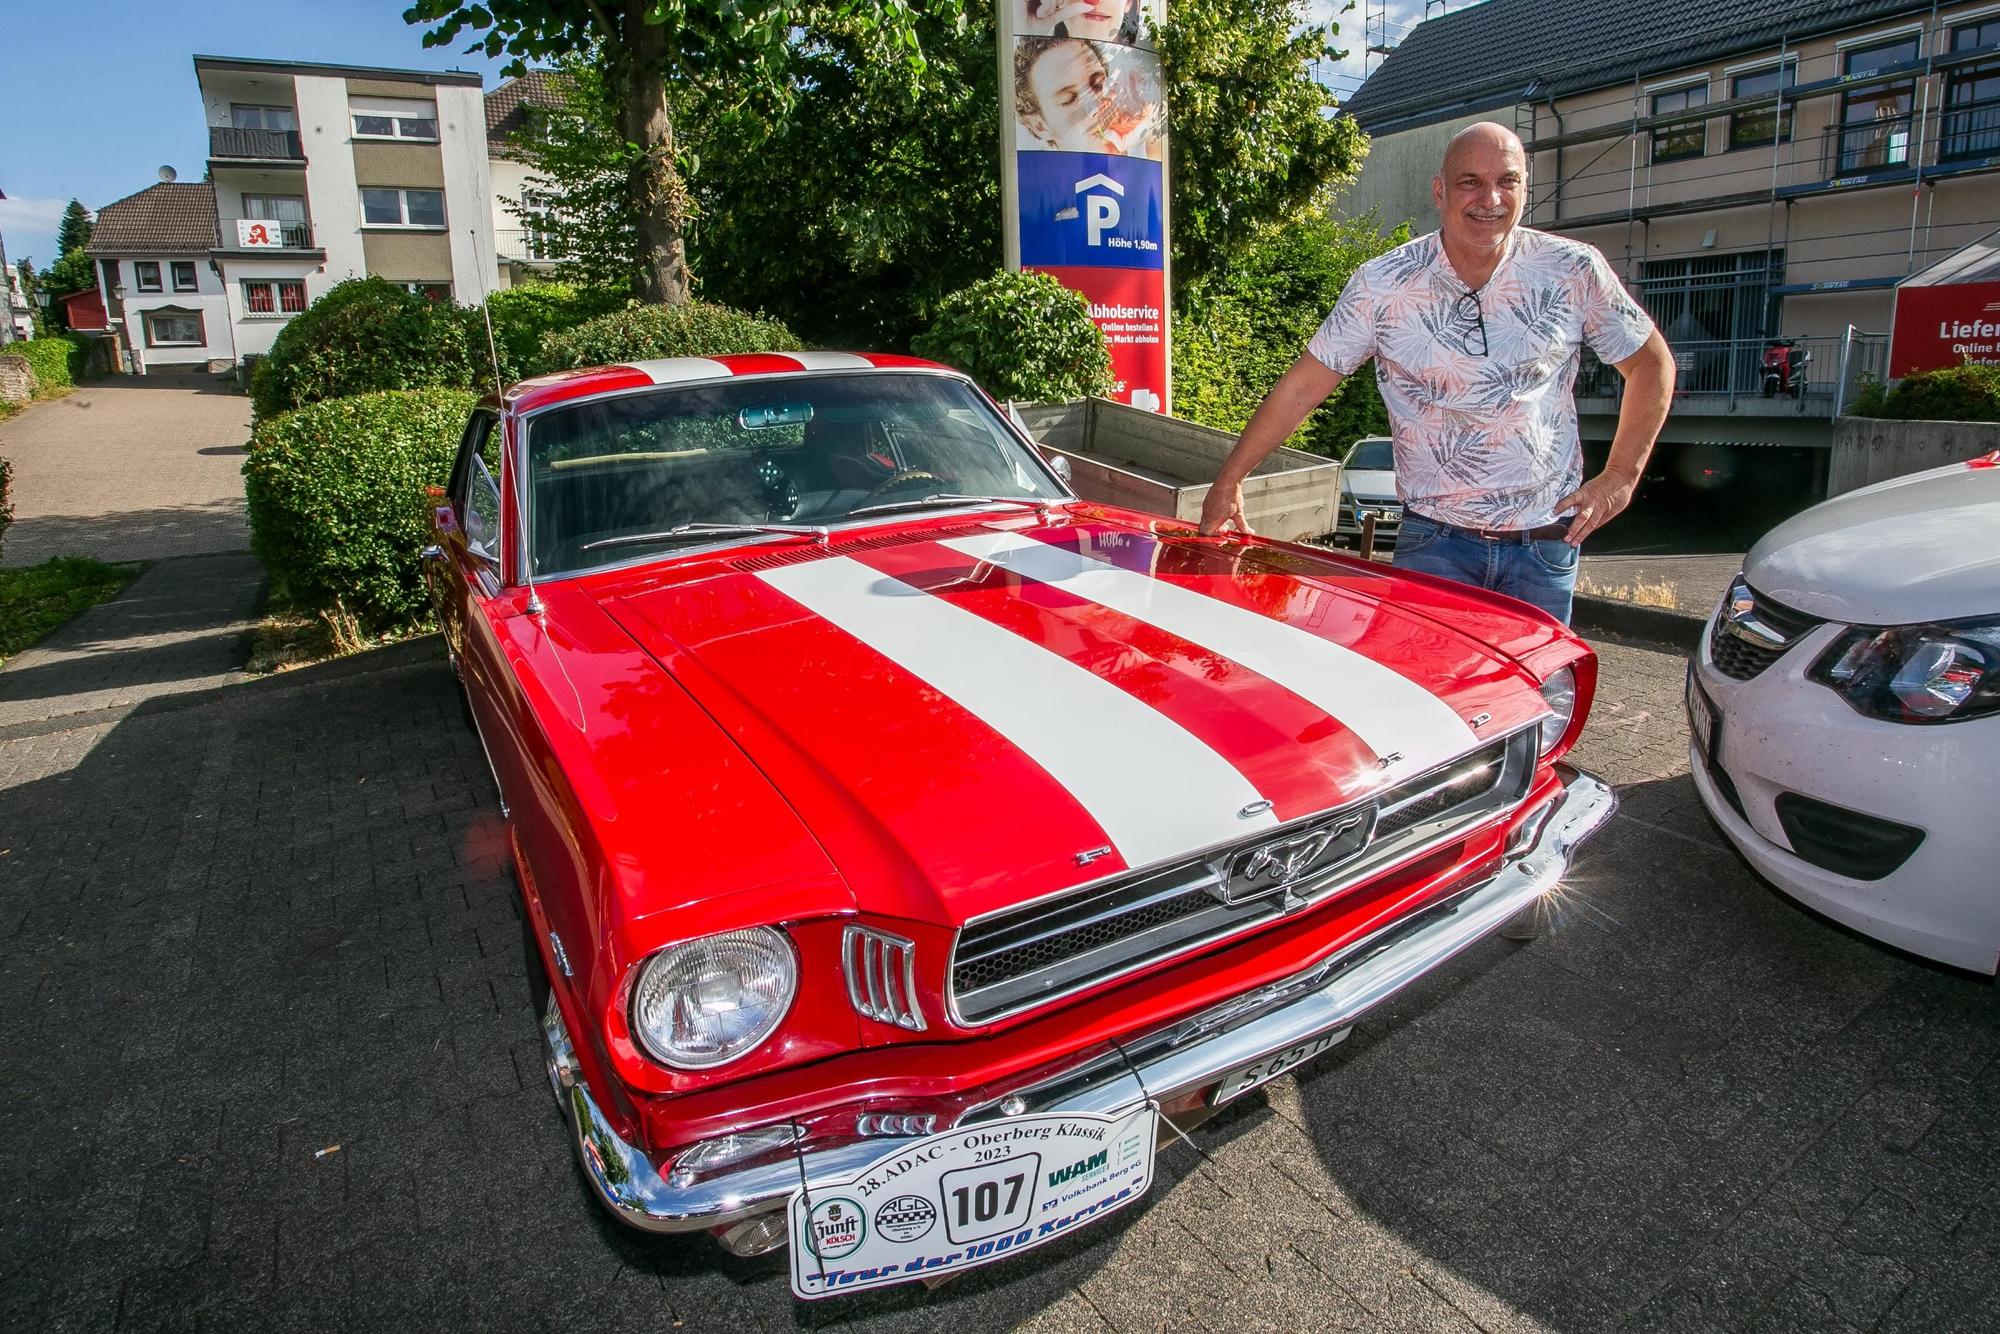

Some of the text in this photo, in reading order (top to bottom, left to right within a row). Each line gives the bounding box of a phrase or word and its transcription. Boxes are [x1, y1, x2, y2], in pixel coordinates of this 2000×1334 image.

[1087, 195, 1120, 246] P
[1108, 237, 1158, 251] Höhe 1,90m
[1086, 303, 1159, 320] Abholservice
[1101, 323, 1124, 332] Online
[1125, 323, 1153, 332] bestellen
[1114, 334, 1134, 343] Markt
[1135, 335, 1159, 343] abholen
[1952, 342, 1993, 353] Online
[858, 1145, 944, 1198] 28.ADAC
[963, 1126, 1052, 1150] Oberberg
[1055, 1122, 1107, 1142] Klassik
[974, 1145, 1012, 1164] 2023
[1048, 1148, 1108, 1188] WAM
[1061, 1177, 1108, 1202] Volksbank
[1109, 1166, 1129, 1180] Berg
[1130, 1158, 1142, 1171] eG
[952, 1172, 1025, 1227] 107
[826, 1233, 856, 1246] KÖLSCH
[904, 1252, 963, 1273] der
[964, 1227, 1034, 1261] 1000
